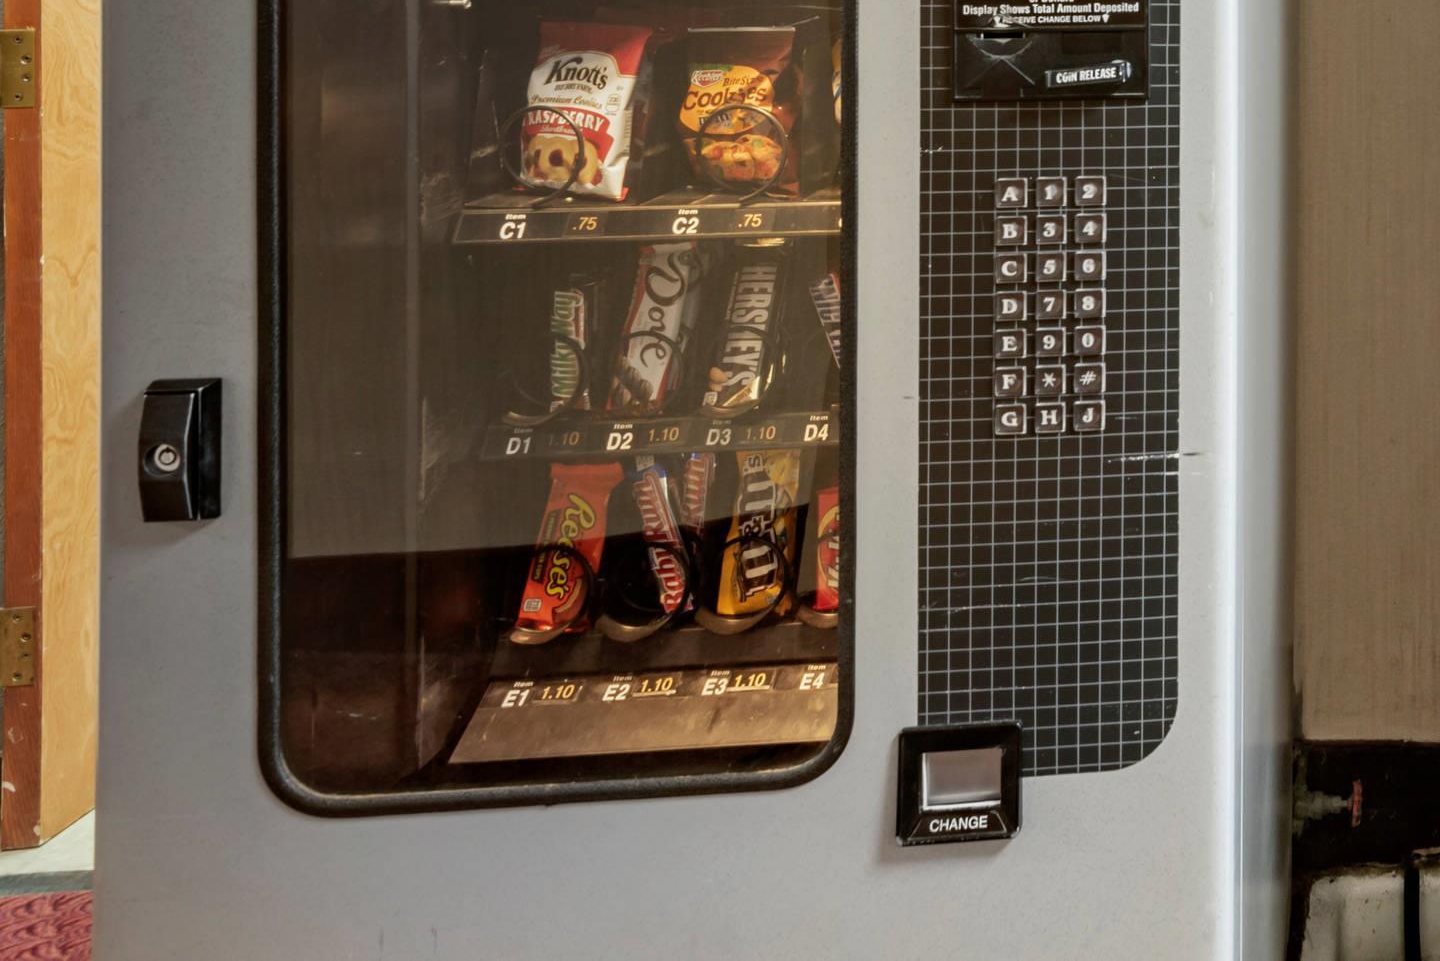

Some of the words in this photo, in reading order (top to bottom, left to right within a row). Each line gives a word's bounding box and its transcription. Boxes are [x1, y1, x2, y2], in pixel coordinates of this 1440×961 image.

[962, 5, 998, 16] Display
[1000, 5, 1030, 14] Shows
[1032, 4, 1054, 14] Total
[1057, 4, 1092, 14] Amount
[1093, 2, 1140, 14] Deposited
[1038, 15, 1070, 24] CHANGE
[1072, 14, 1101, 23] BELOW
[544, 56, 608, 90] Knott's
[1079, 67, 1116, 82] RELEASE
[528, 109, 605, 132] RASPBERRY
[1001, 187, 1018, 202] A
[1044, 184, 1056, 201] 1
[1082, 184, 1098, 200] 2
[500, 221, 527, 239] C1
[572, 216, 598, 231] .75
[672, 216, 699, 234] C2
[738, 213, 762, 228] .75
[1002, 223, 1018, 240] B
[1043, 222, 1056, 238] 3
[1082, 220, 1097, 236] 4
[1001, 261, 1018, 277] C
[1043, 260, 1056, 275] 5
[1082, 258, 1096, 274] 6
[1002, 299, 1018, 314] D
[1044, 296, 1056, 313] 7
[1082, 296, 1095, 311] 8
[550, 290, 584, 338] Way
[722, 266, 777, 386] HERSHEY'S
[1002, 336, 1018, 352] E
[1042, 334, 1056, 350] 9
[1082, 333, 1095, 348] 0
[1002, 374, 1018, 390] F
[1001, 411, 1018, 427] G
[1040, 410, 1058, 425] H
[1082, 406, 1094, 424] J
[606, 432, 634, 451] D2
[648, 427, 679, 442] 1.10
[706, 428, 732, 446] D3
[746, 426, 776, 440] 1.10
[804, 424, 829, 442] D4
[506, 437, 532, 455] D1
[546, 493, 596, 600] Reese's
[514, 680, 534, 688] Item
[602, 684, 630, 702] E2
[640, 677, 674, 693] 1.10
[700, 678, 728, 696] E3
[733, 672, 767, 688] 1.10
[800, 672, 824, 690] E4
[501, 690, 530, 708] E1
[540, 684, 575, 700] 1.10
[929, 815, 988, 833] CHANGE
